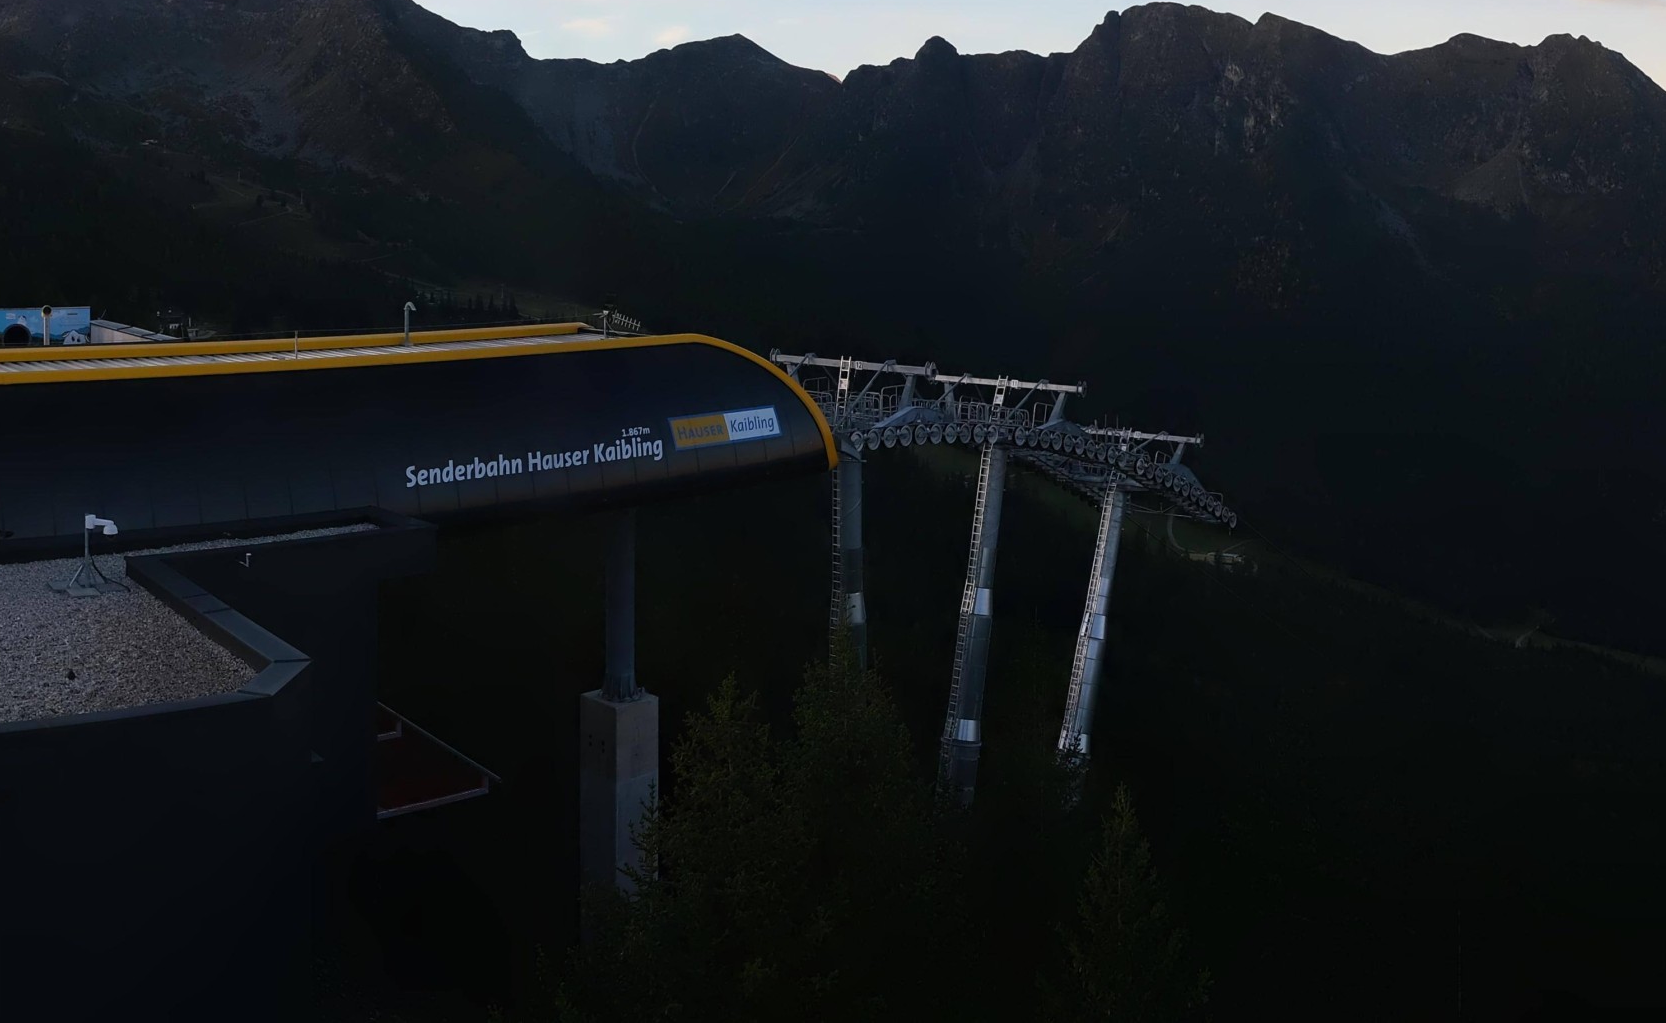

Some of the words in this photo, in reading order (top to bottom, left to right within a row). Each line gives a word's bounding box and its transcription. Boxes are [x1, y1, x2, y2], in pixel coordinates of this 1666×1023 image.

[621, 426, 650, 438] 1.867m
[676, 424, 725, 442] HAUSER
[730, 414, 775, 435] Kaibling
[405, 453, 523, 489] Senderbahn
[527, 447, 590, 472] Hauser
[593, 437, 664, 463] Kaibling
